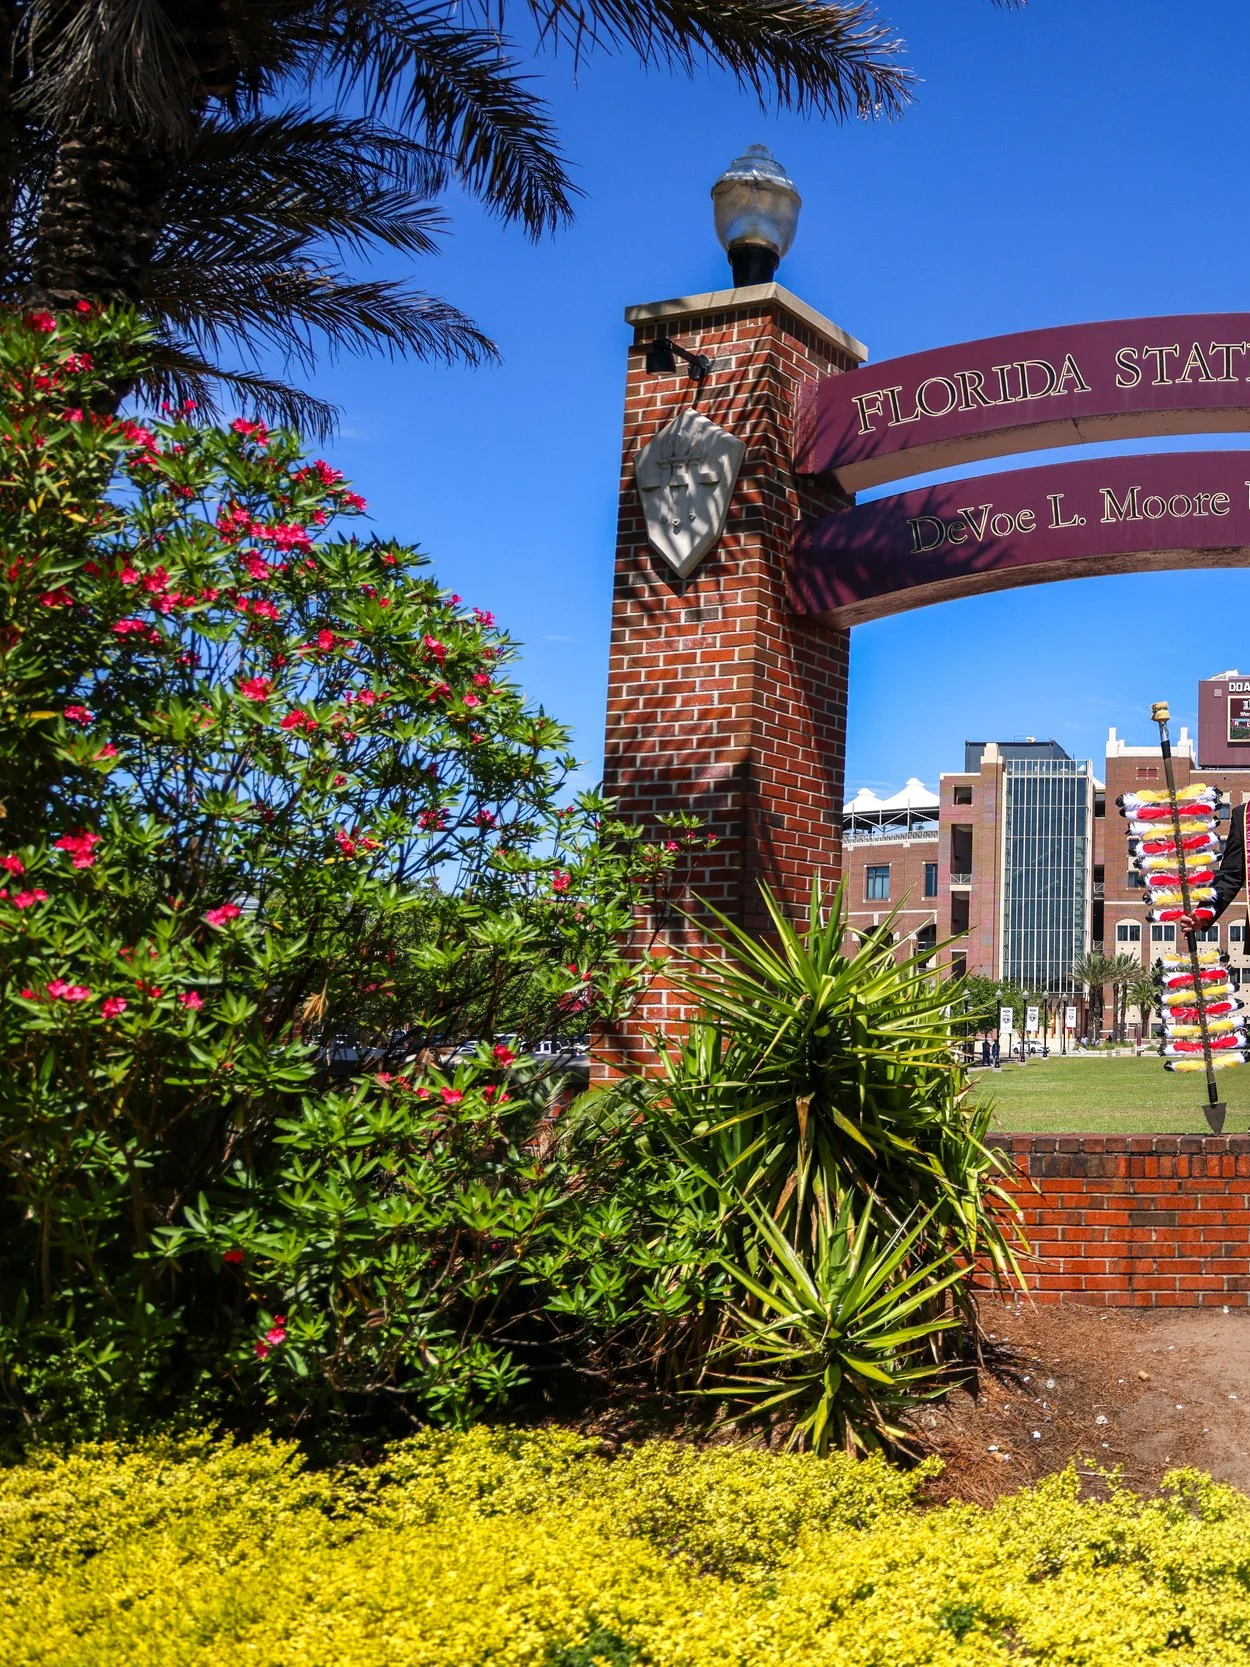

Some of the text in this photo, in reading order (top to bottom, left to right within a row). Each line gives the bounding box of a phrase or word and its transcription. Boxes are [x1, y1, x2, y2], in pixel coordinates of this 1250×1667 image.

[852, 354, 1091, 435] FLORIDA
[906, 504, 1036, 554] DeVoe
[1047, 493, 1087, 529] L.
[1099, 486, 1231, 523] Moore
